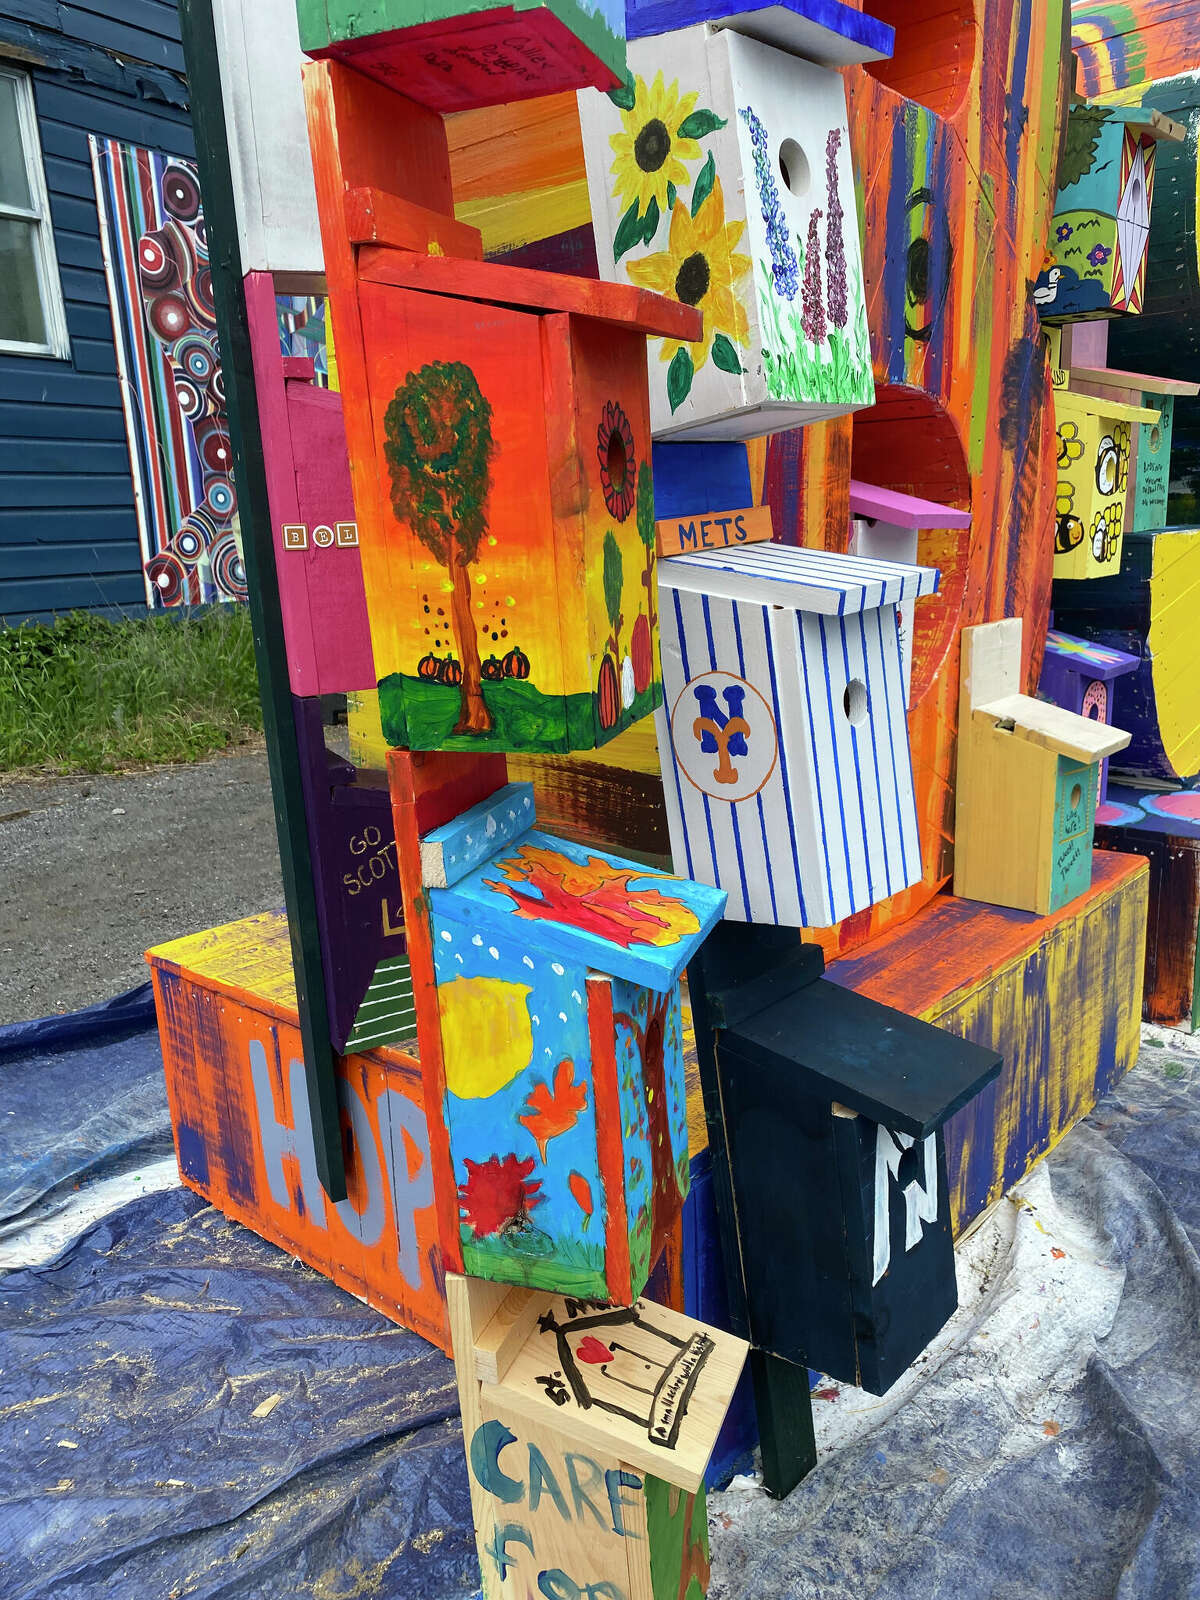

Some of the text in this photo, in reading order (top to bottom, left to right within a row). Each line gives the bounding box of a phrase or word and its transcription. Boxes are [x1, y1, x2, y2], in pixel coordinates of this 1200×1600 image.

[679, 515, 748, 550] METS
[349, 826, 381, 855] GO
[470, 1419, 643, 1540] CARE
